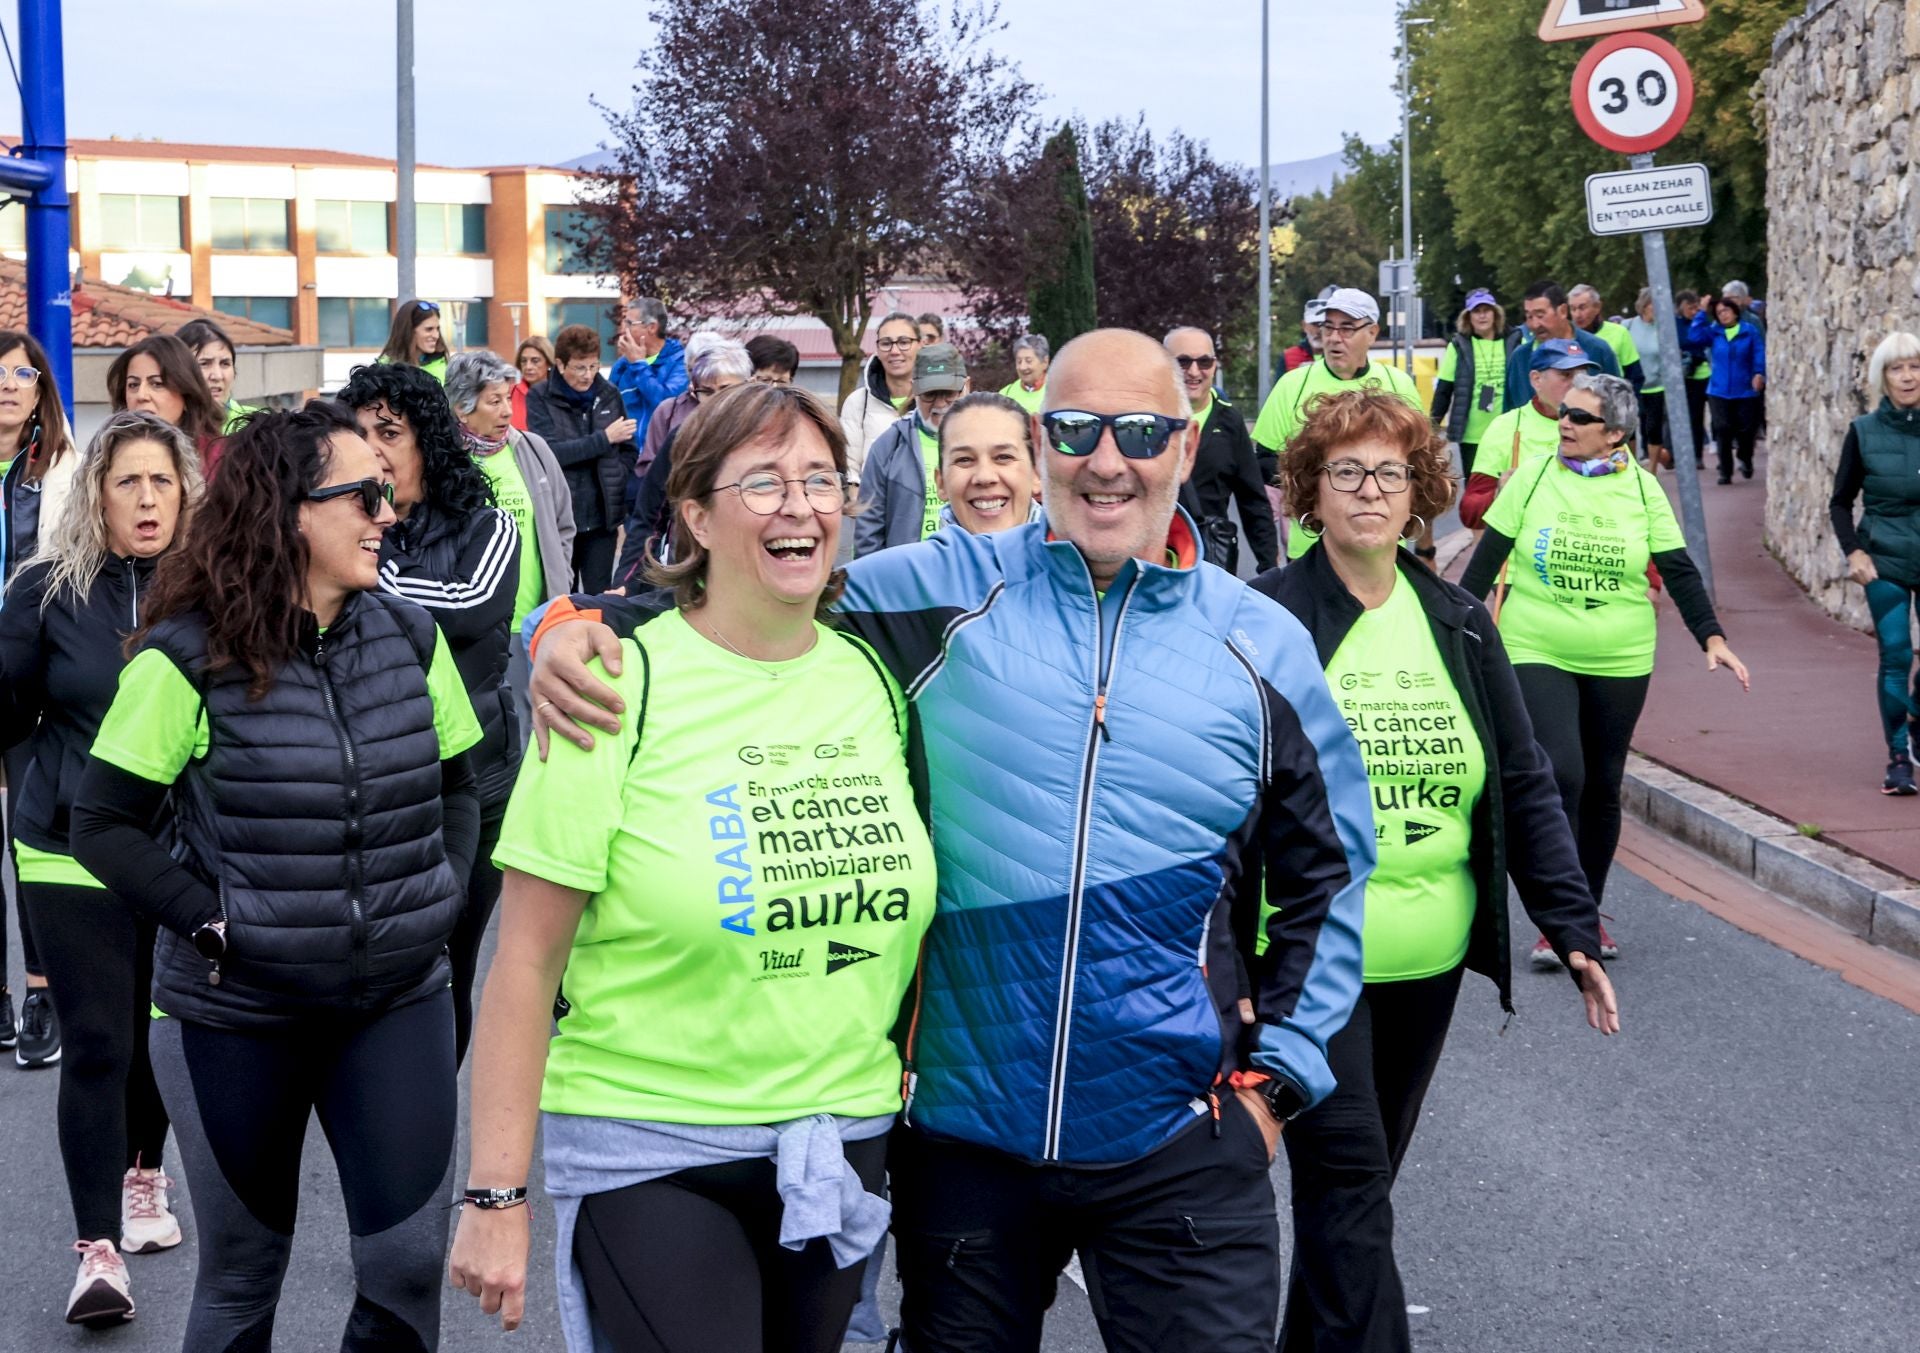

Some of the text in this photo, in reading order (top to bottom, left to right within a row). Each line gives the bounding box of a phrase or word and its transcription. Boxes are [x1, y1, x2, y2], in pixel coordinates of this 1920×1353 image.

[1599, 69, 1667, 115] 30
[1602, 177, 1693, 196] KALEAN ZEHAR
[1597, 212, 1613, 223] EN
[1650, 207, 1664, 217] LA
[1665, 202, 1704, 214] CALLE
[1533, 527, 1552, 586] ARABA
[1553, 536, 1626, 555] el cáncer
[1549, 562, 1624, 578] minbiziaren
[1550, 550, 1626, 568] martxan
[1553, 572, 1620, 592] aurka
[1343, 699, 1357, 711] En
[1361, 699, 1408, 711] marcha
[1345, 713, 1457, 732] el cáncer
[1366, 760, 1467, 776] inbiziaren
[748, 780, 767, 797] En
[832, 773, 883, 789] contra
[1374, 778, 1461, 811] urka
[752, 792, 890, 823] el cáncer
[758, 820, 905, 854] martxan
[705, 783, 756, 936] ARABA
[763, 853, 912, 883] minbiziaren
[766, 879, 910, 933] aurka
[759, 948, 804, 971] Vital
